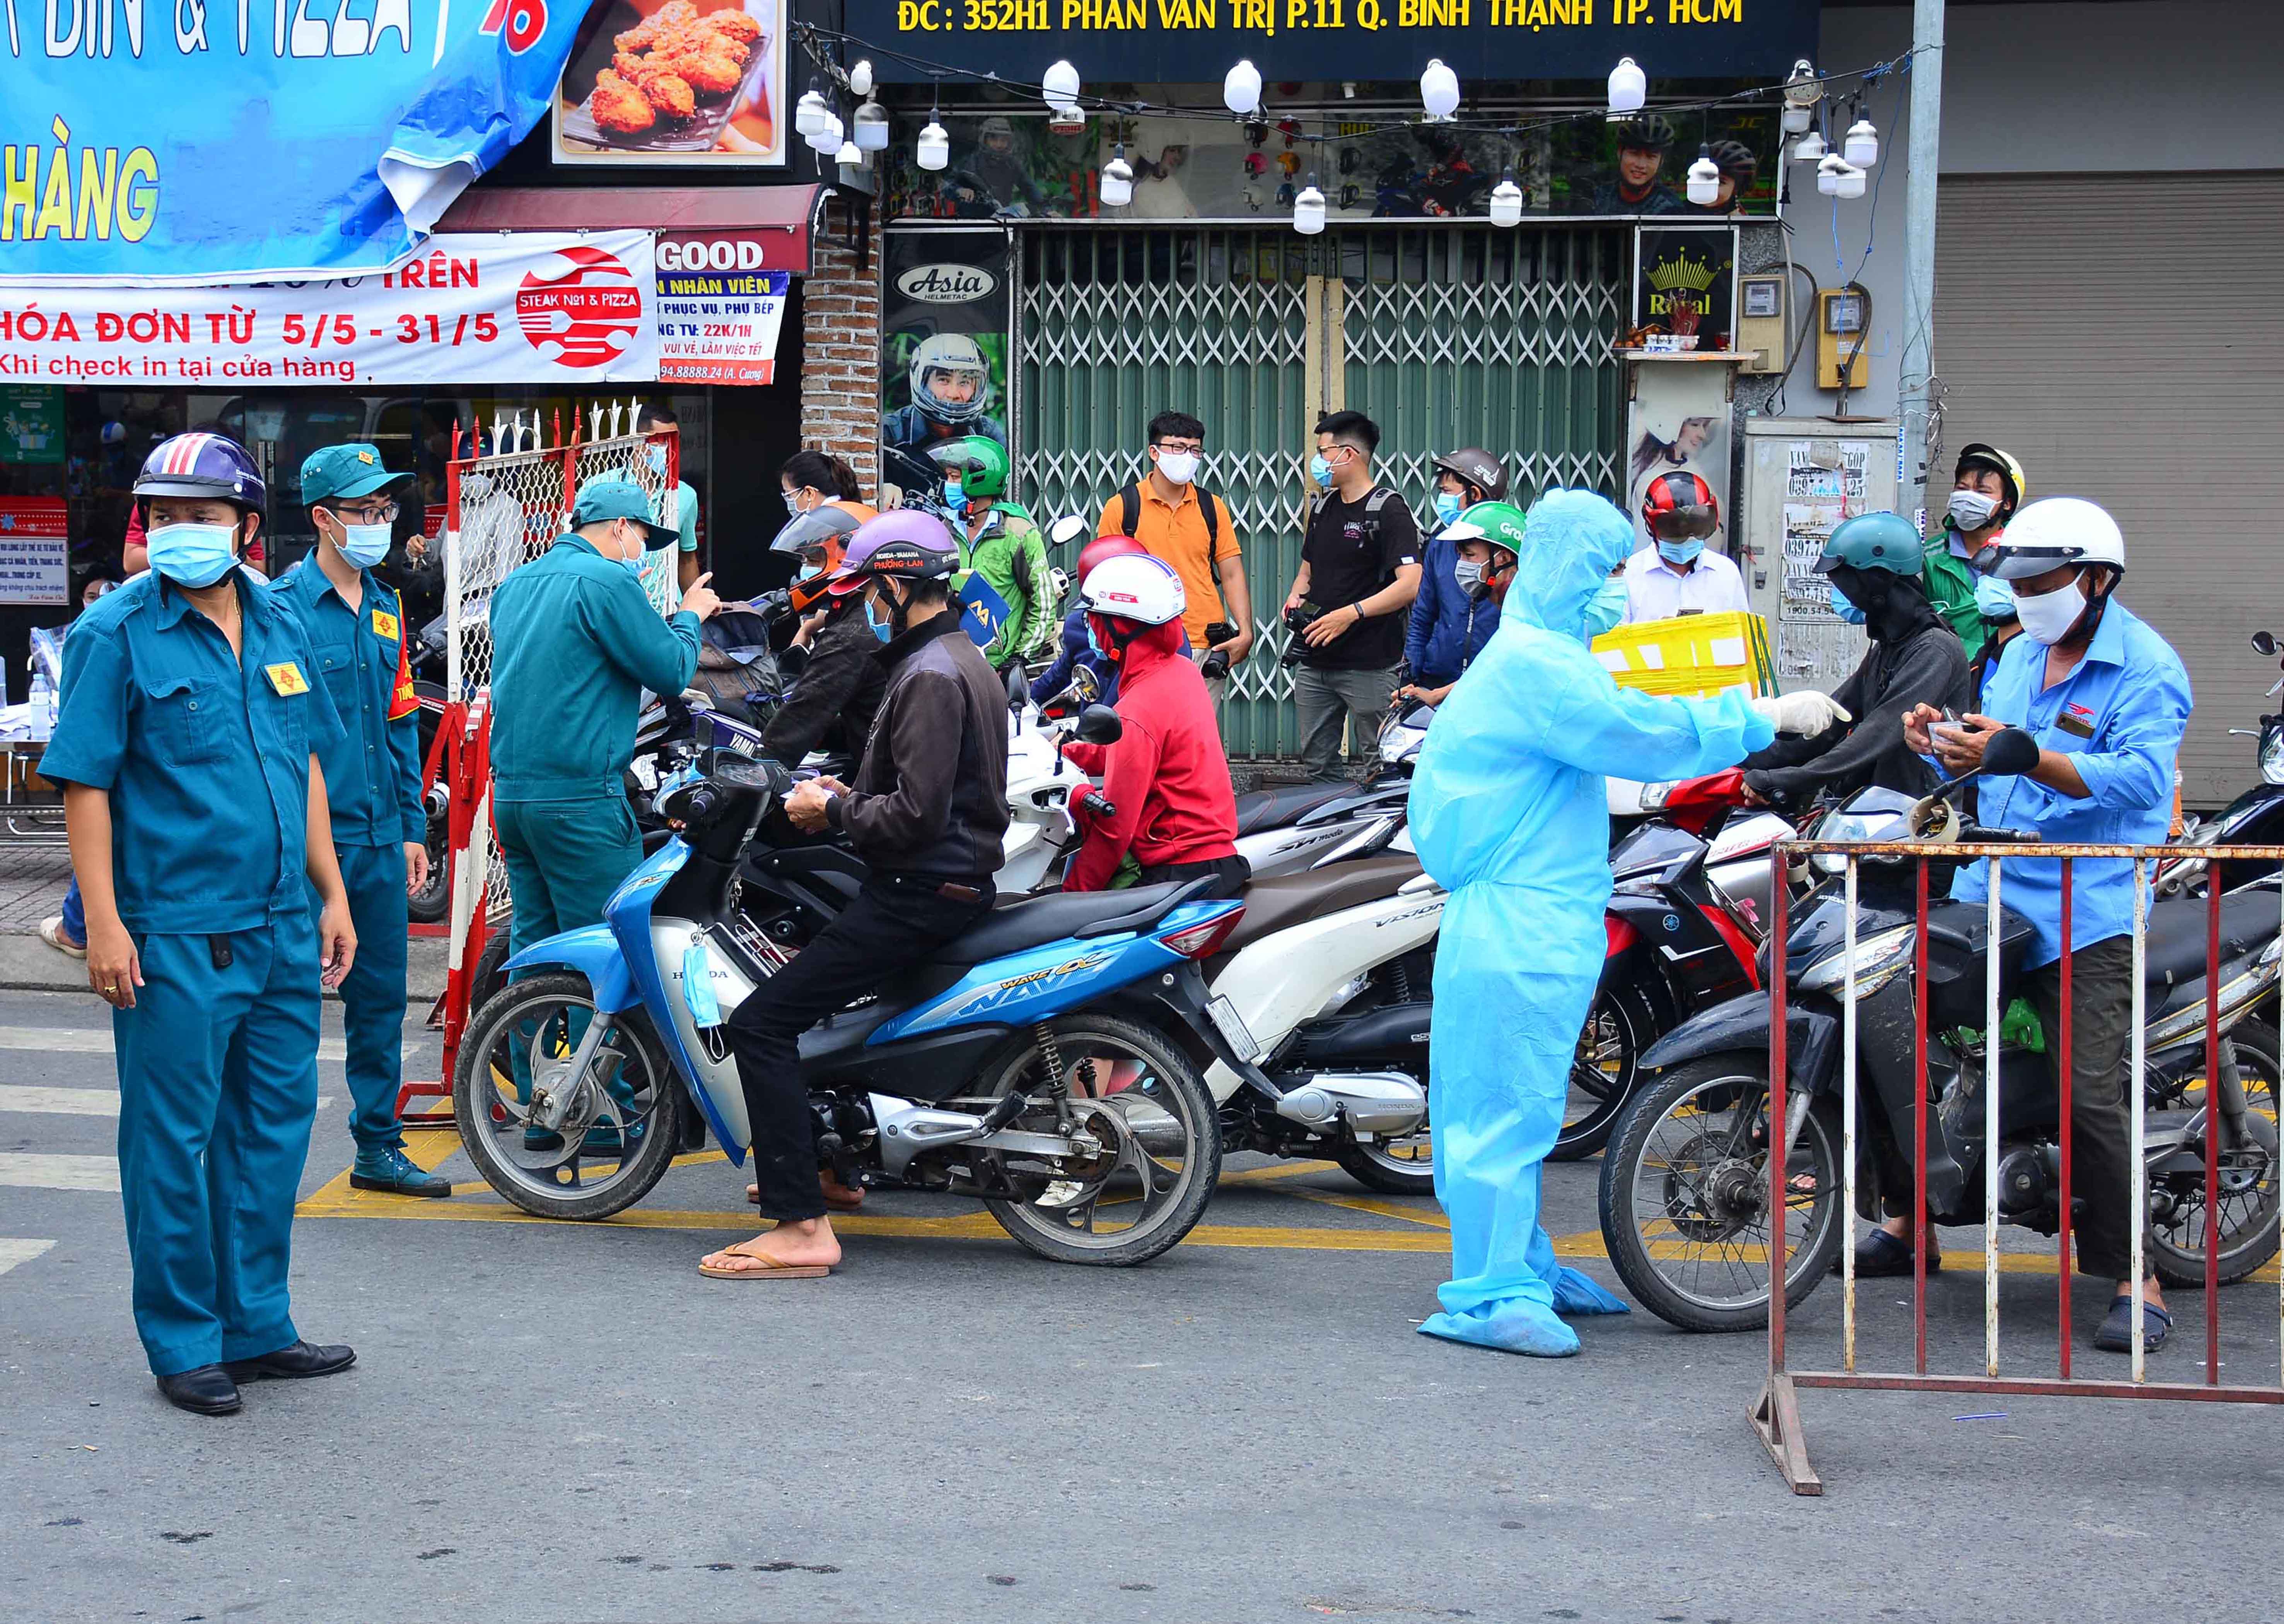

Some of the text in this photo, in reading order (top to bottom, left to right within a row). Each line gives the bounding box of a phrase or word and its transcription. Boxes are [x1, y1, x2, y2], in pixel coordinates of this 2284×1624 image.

[964, 0, 1050, 30] 352H1
[1062, 0, 1146, 29] PHAN
[1229, 0, 1274, 35] TRỊ
[1357, 0, 1388, 31] Q.
[1489, 0, 1593, 31] THẠNH
[1669, 0, 1742, 23] HCM
[1, 114, 160, 243] HÀNG
[656, 241, 763, 270] GOOD
[670, 276, 722, 294] NHÂN
[727, 276, 770, 294] VIÊN
[909, 269, 983, 293] Asia
[520, 294, 559, 307] STEAK
[589, 294, 598, 306] &
[602, 293, 637, 307] PIZZA
[665, 303, 697, 318] PHỤC
[725, 302, 749, 317] PHỤ
[95, 308, 190, 343] ĐƠN
[205, 304, 256, 344] TỪ
[282, 314, 356, 348] 5/5
[704, 324, 751, 337] 22K/1H
[664, 343, 680, 353] VUI
[702, 341, 722, 354] LÀM
[49, 355, 132, 376] check
[143, 356, 166, 376] in
[178, 356, 211, 381] tại
[223, 353, 272, 377] cửa
[283, 357, 355, 381] hàng
[673, 971, 729, 979] HDA
[1000, 967, 1053, 990] WAVE
